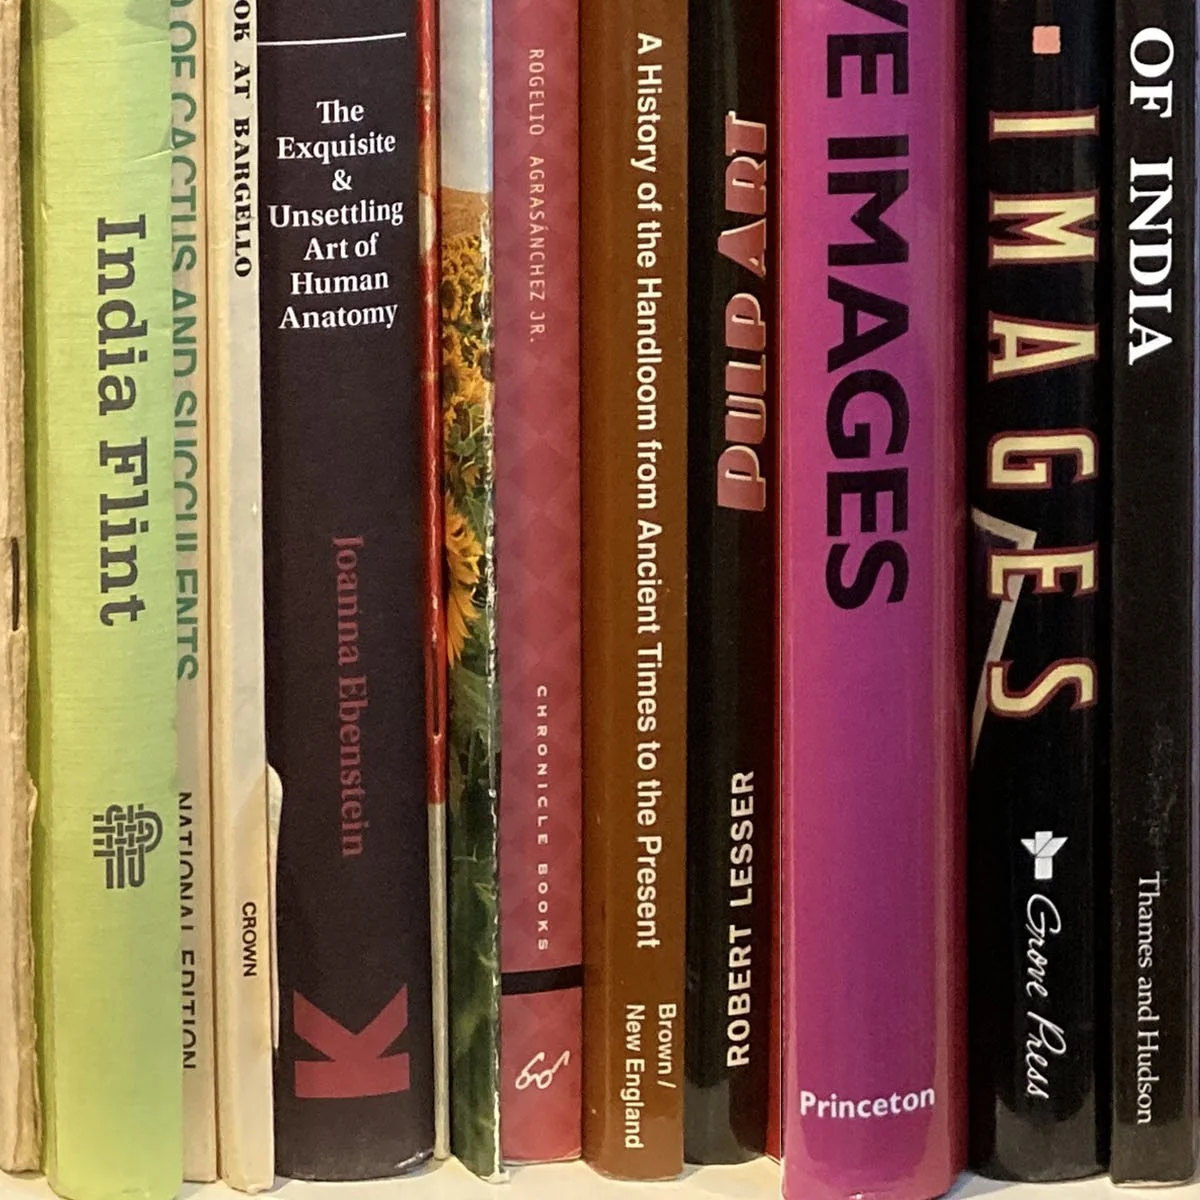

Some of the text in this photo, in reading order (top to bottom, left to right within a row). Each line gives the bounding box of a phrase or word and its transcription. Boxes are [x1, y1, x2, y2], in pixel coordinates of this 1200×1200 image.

[277, 132, 396, 162] Exquisite
[316, 100, 364, 124] The
[528, 48, 545, 137] ROGELIO
[1129, 27, 1175, 119] OF
[233, 119, 253, 277] BARGELLO
[268, 200, 403, 229] Unsettling
[304, 233, 378, 261] Art of
[1128, 156, 1173, 366] INDIA
[279, 304, 398, 330] Anatomy
[290, 272, 389, 296] Human
[717, 110, 767, 511] PULP ART
[97, 213, 149, 627] India Flint
[826, 134, 910, 610] IMAGES
[986, 110, 1099, 718] IMAGES
[631, 63, 663, 949] History the Handloom from Ancient Times the Present
[333, 536, 368, 858] Joanna Ebenstein
[537, 686, 549, 950] CHRONICLE BOOKS
[242, 902, 257, 977] CROWN
[727, 771, 754, 1066] ROBERT LESSER
[657, 1003, 677, 1074] Brown
[1026, 893, 1067, 1100] Grove Press
[1136, 871, 1161, 1125] Thames and Hudson
[620, 1004, 645, 1149] New England
[800, 1088, 935, 1119] Princeton
